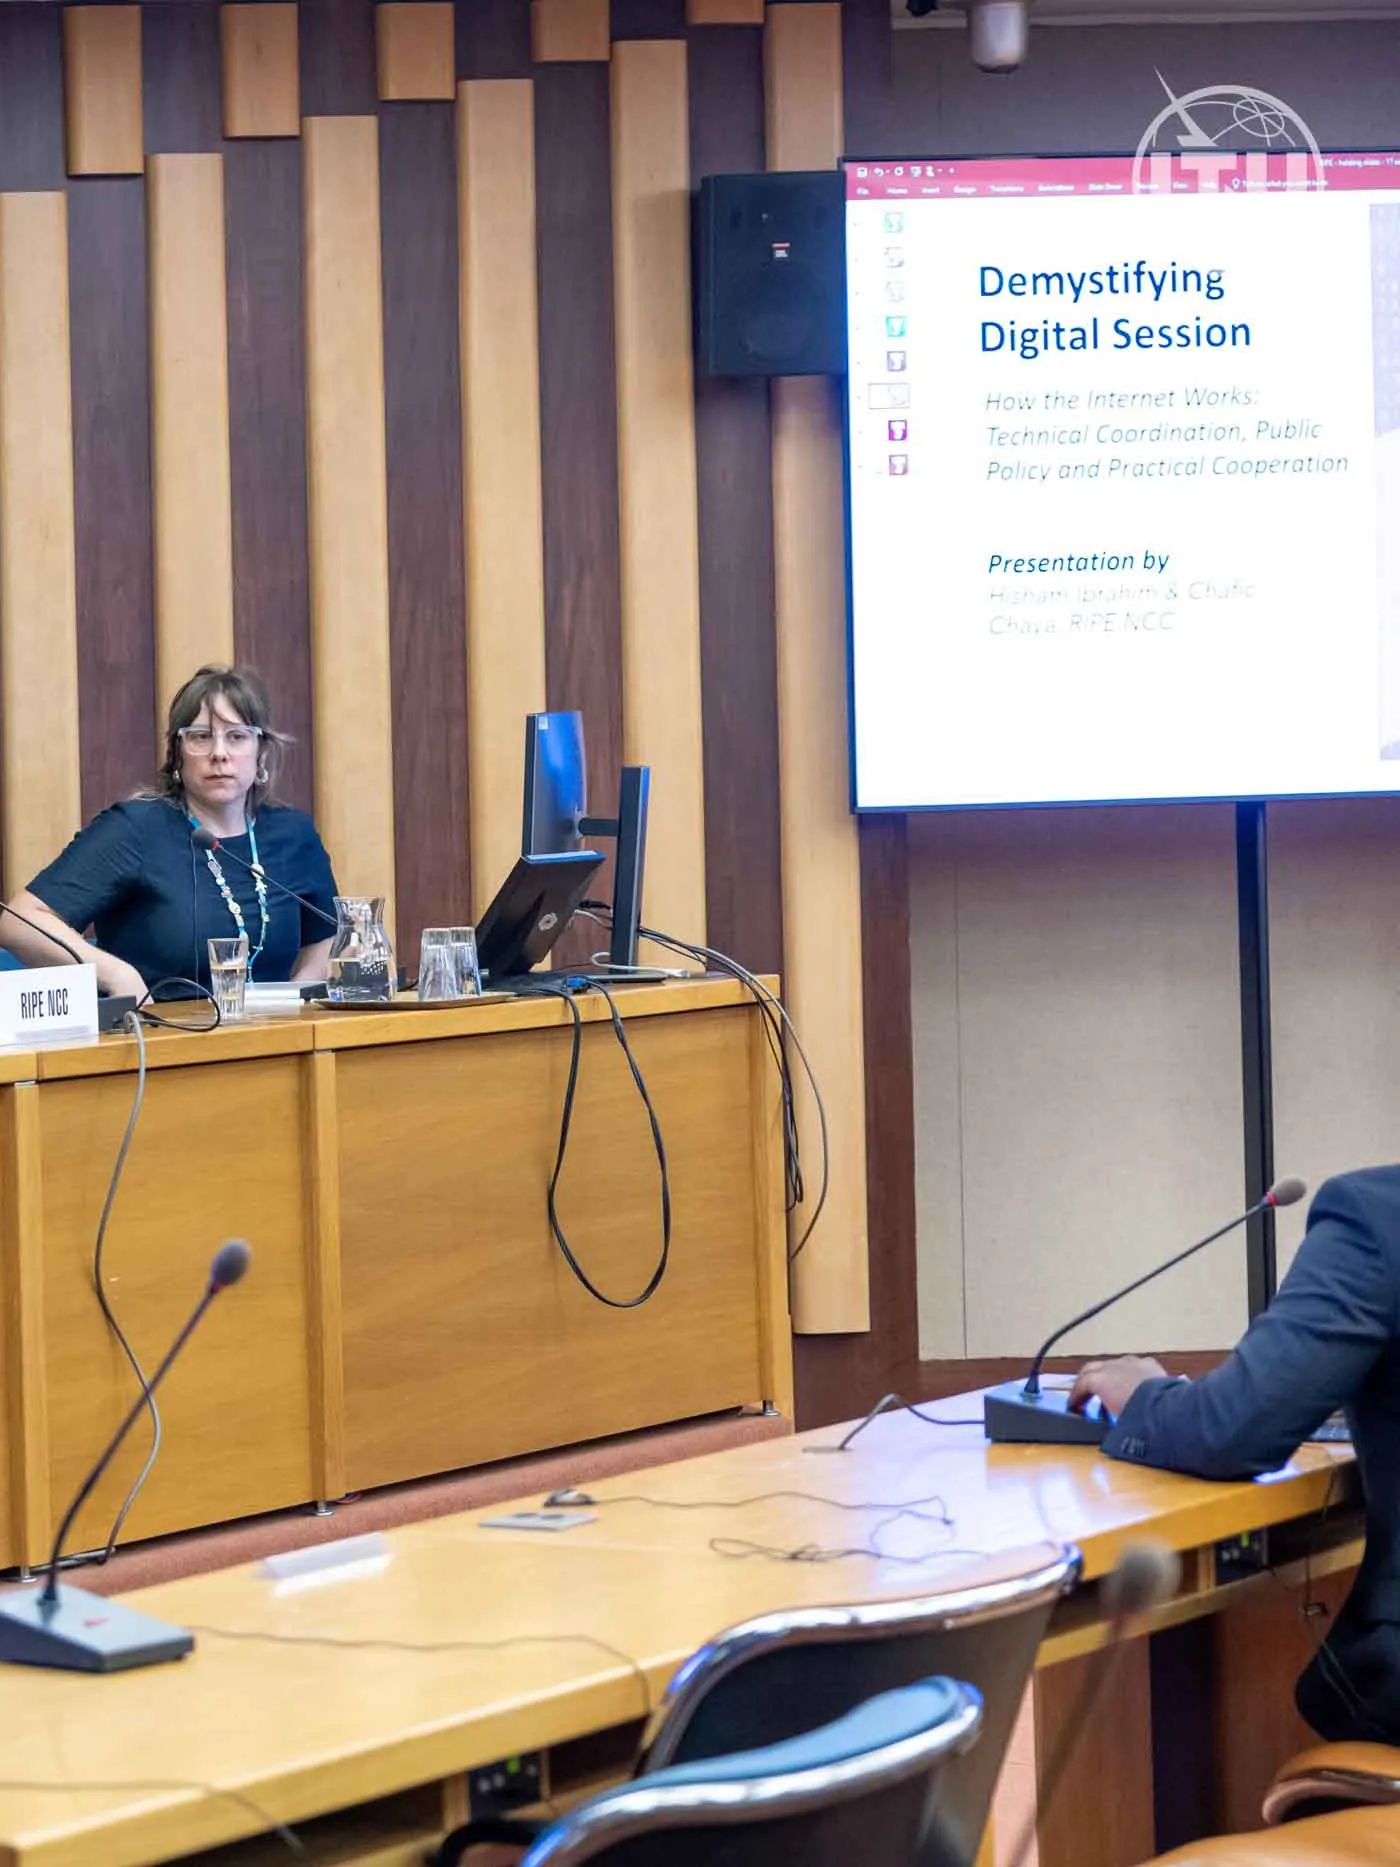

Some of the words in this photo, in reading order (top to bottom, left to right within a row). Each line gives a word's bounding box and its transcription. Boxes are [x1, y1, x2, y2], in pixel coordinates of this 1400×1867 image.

[979, 259, 1226, 304] Demystifying
[980, 316, 1100, 360] Digital
[1112, 315, 1252, 350] Session
[985, 392, 1036, 413] How
[1044, 390, 1080, 411] the
[1087, 388, 1176, 411] Internet
[1184, 385, 1261, 409] Works:
[987, 425, 1089, 447] Technical
[1096, 421, 1248, 445] Coordination,
[1256, 419, 1323, 441] Public
[986, 461, 1052, 483] Policy
[1058, 459, 1101, 480] and
[1108, 456, 1205, 479] Practical
[1211, 453, 1350, 480] Cooperation
[988, 551, 1135, 575] Presentation
[1142, 548, 1171, 575] by
[1123, 609, 1176, 632] NCC
[20, 991, 44, 1019] RIPE
[48, 987, 69, 1017] NCC
